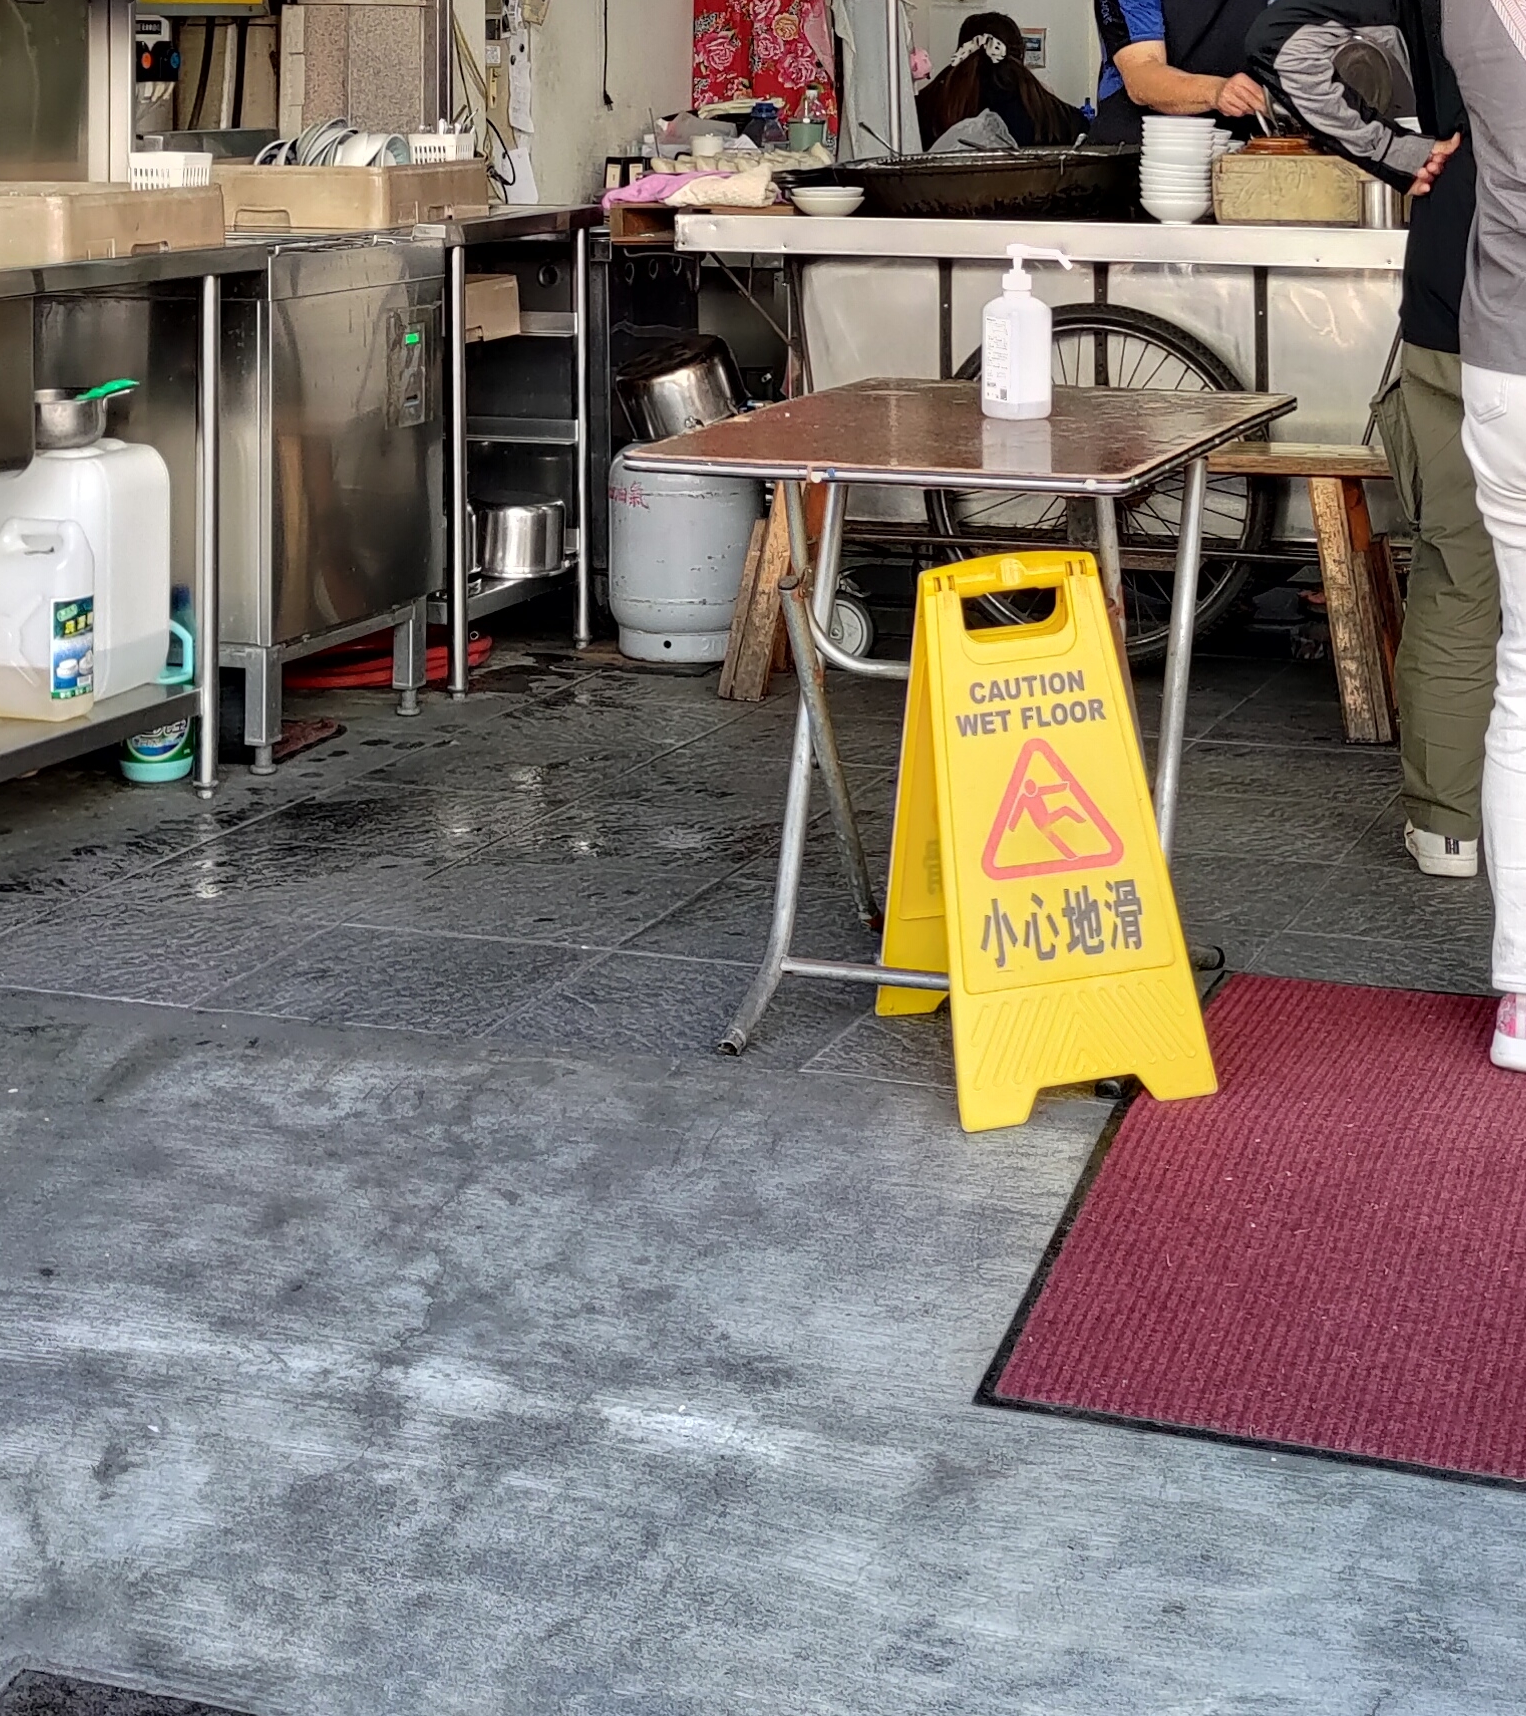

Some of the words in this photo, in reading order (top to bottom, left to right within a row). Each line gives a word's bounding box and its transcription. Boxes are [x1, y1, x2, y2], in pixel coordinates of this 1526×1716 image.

[969, 670, 1085, 704] CAUTION
[955, 709, 1011, 737] WET
[1020, 698, 1106, 730] FLOOR
[980, 879, 1142, 968] 小心地滑
